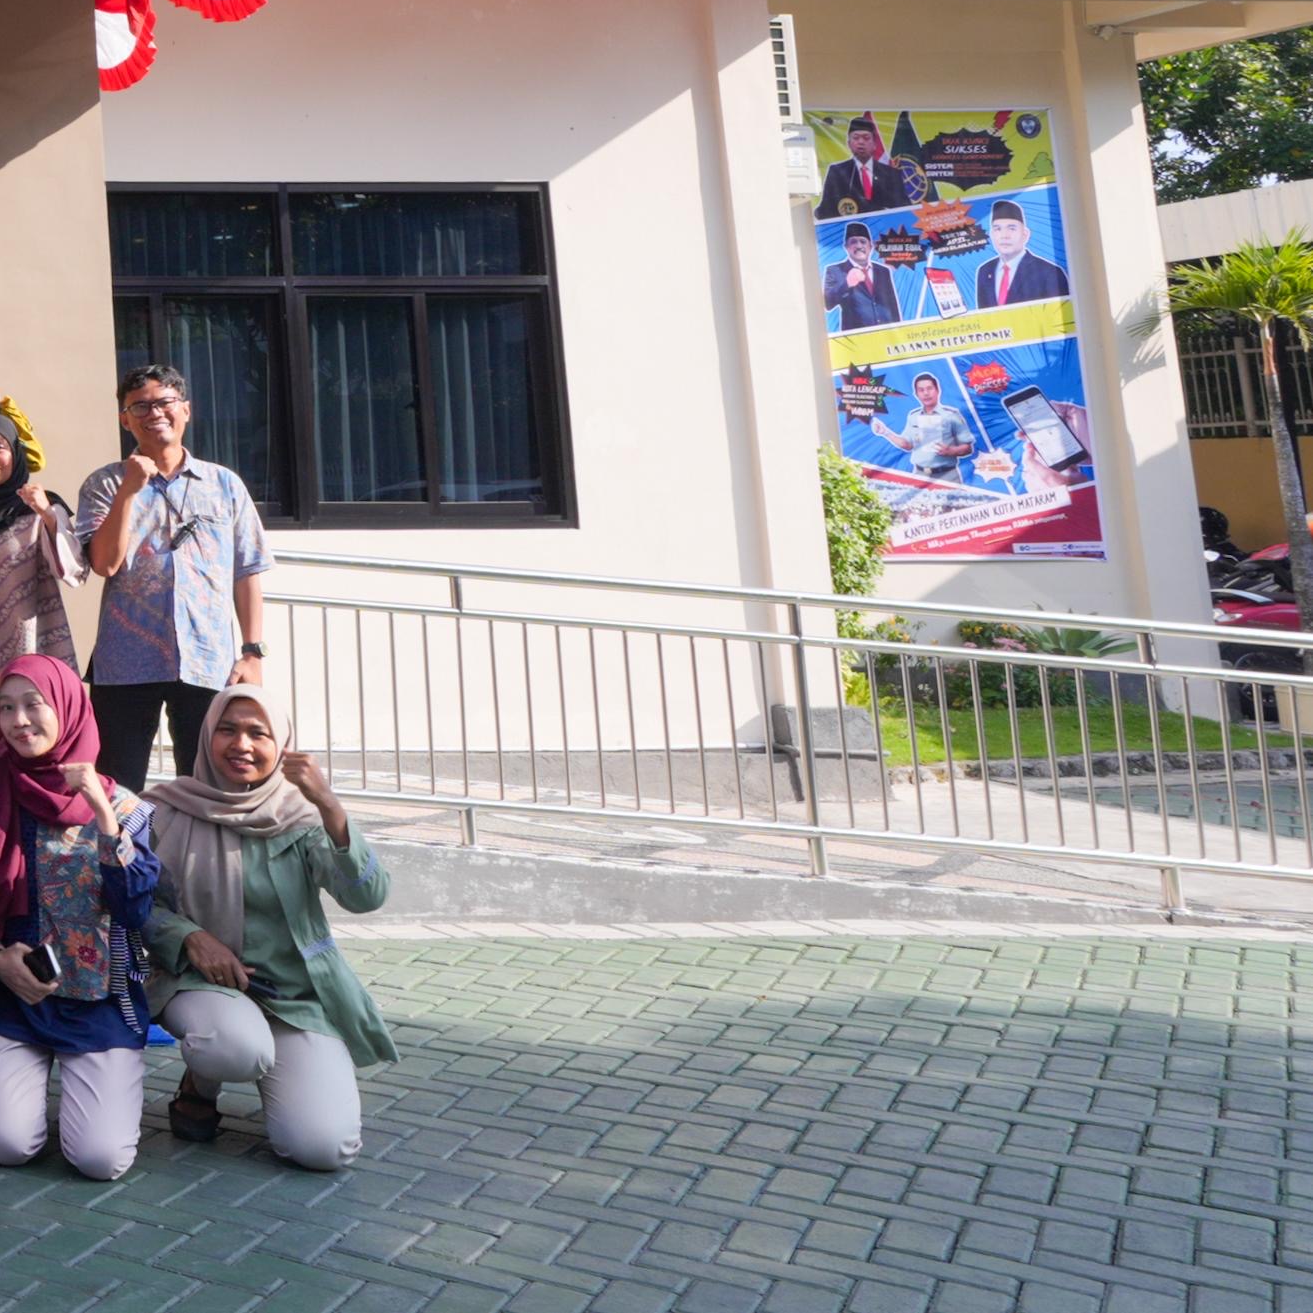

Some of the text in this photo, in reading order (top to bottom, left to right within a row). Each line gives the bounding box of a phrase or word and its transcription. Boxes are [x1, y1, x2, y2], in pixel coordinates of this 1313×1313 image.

[943, 144, 988, 154] SUKSES
[940, 329, 1012, 347] ELEKTRONIK
[904, 491, 1057, 539] KANTOR PERTANAHAN KOTA MATARAM
